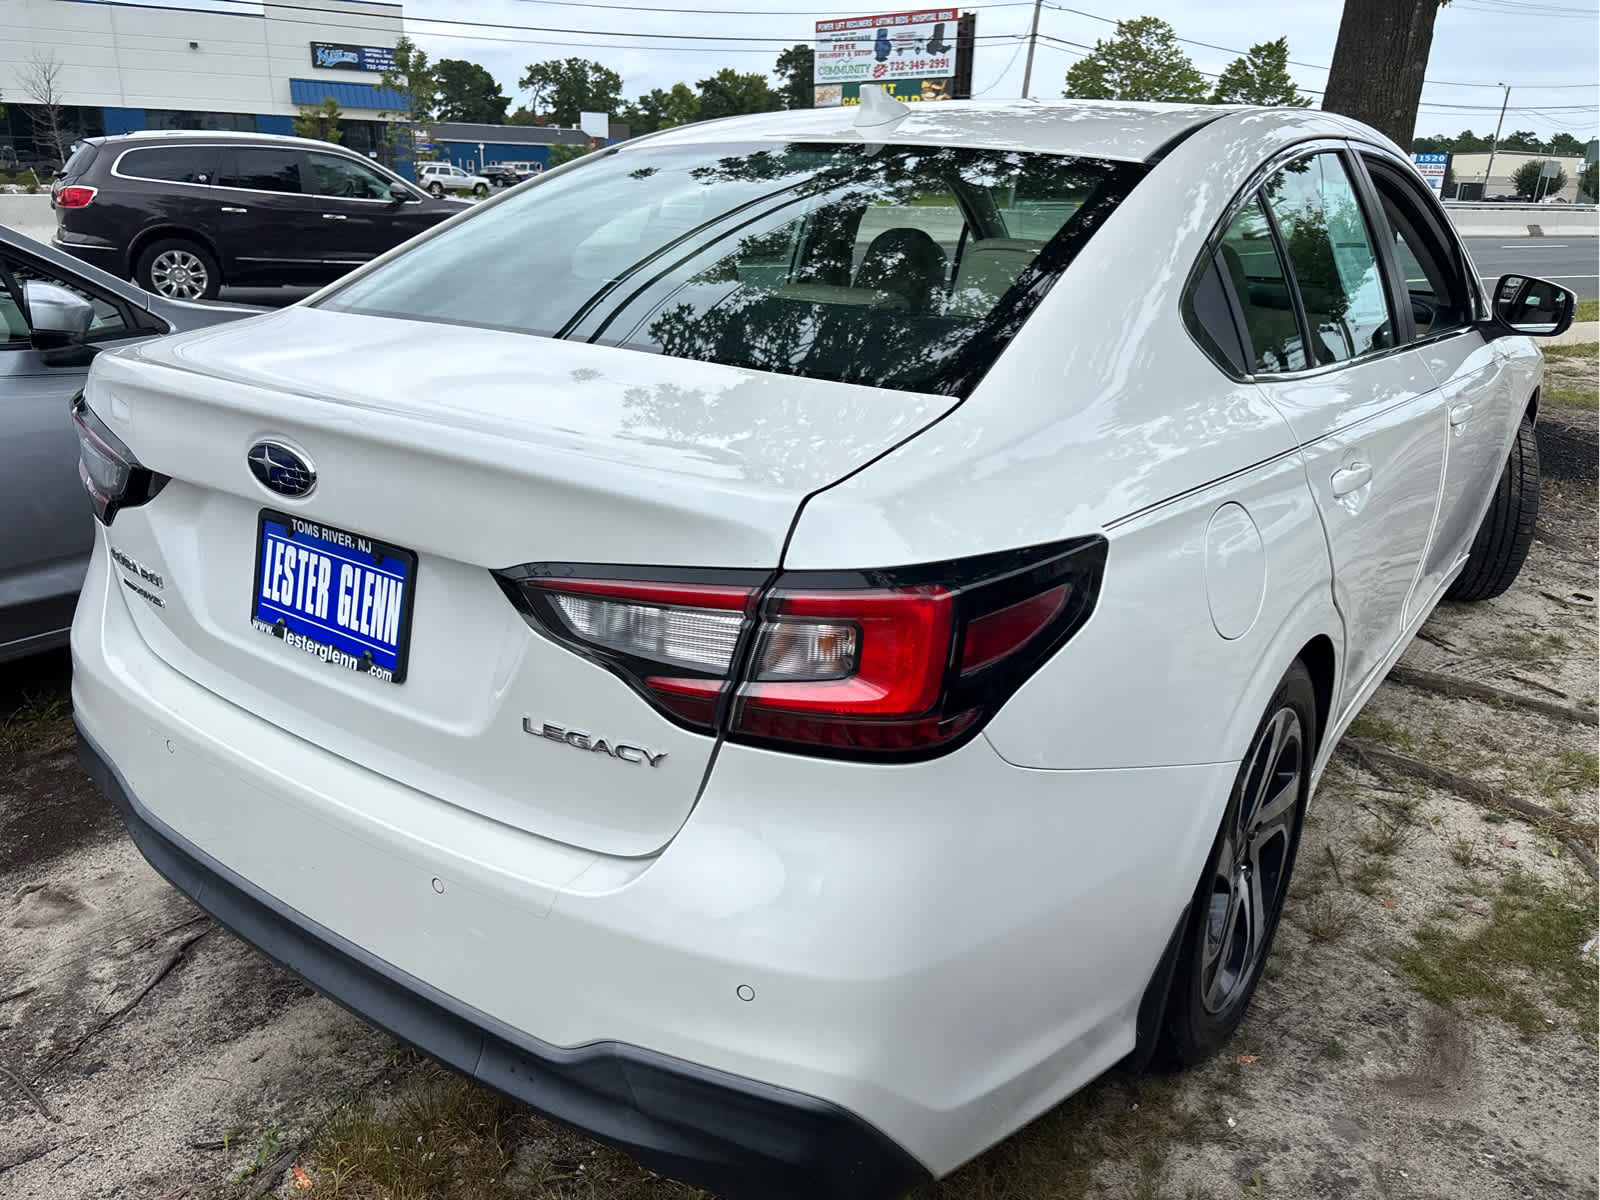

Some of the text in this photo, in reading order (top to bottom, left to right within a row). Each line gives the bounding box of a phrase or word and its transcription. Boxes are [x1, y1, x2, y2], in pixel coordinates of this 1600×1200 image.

[817, 63, 872, 75] COMMUNITY
[889, 57, 949, 71] 732-349-2991
[291, 518, 372, 554] TOMS RIVER, NJ
[262, 539, 404, 647] LESTER GLENN
[283, 627, 358, 671] lesterglenn
[522, 713, 670, 768] LEGACY
